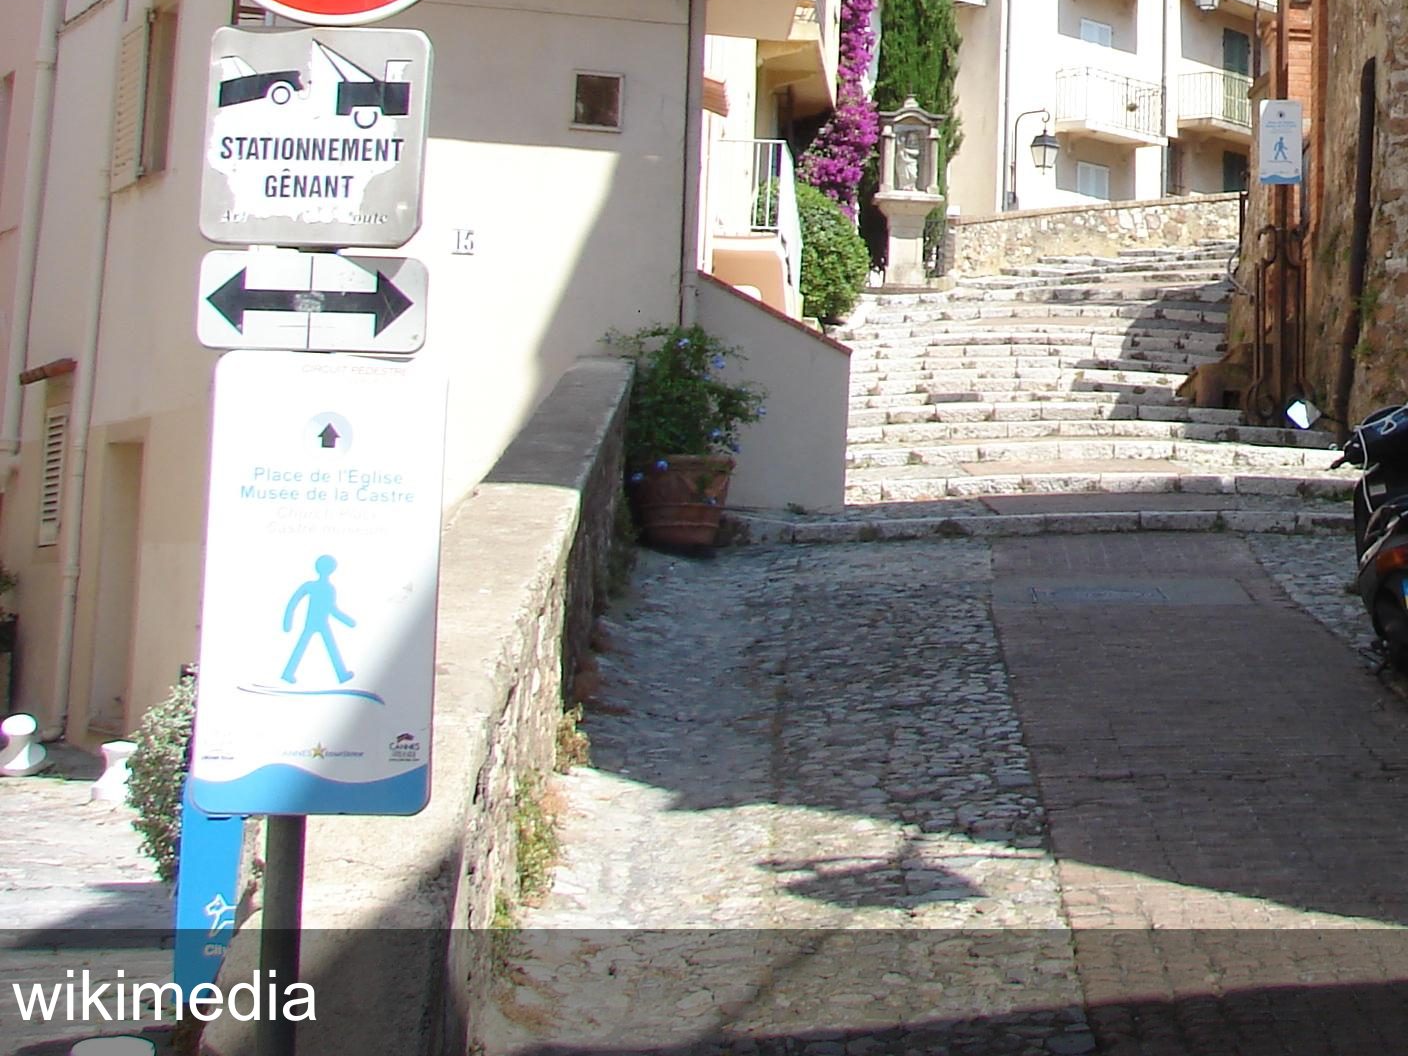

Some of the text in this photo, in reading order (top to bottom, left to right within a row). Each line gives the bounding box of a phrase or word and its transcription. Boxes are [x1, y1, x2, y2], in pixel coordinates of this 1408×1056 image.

[220, 136, 404, 161] STATIONNEMENT
[264, 168, 354, 198] GÊNANT
[254, 466, 304, 483] Place
[310, 468, 332, 484] de
[306, 487, 328, 502] de
[334, 487, 350, 503] la
[356, 487, 416, 504] Castre
